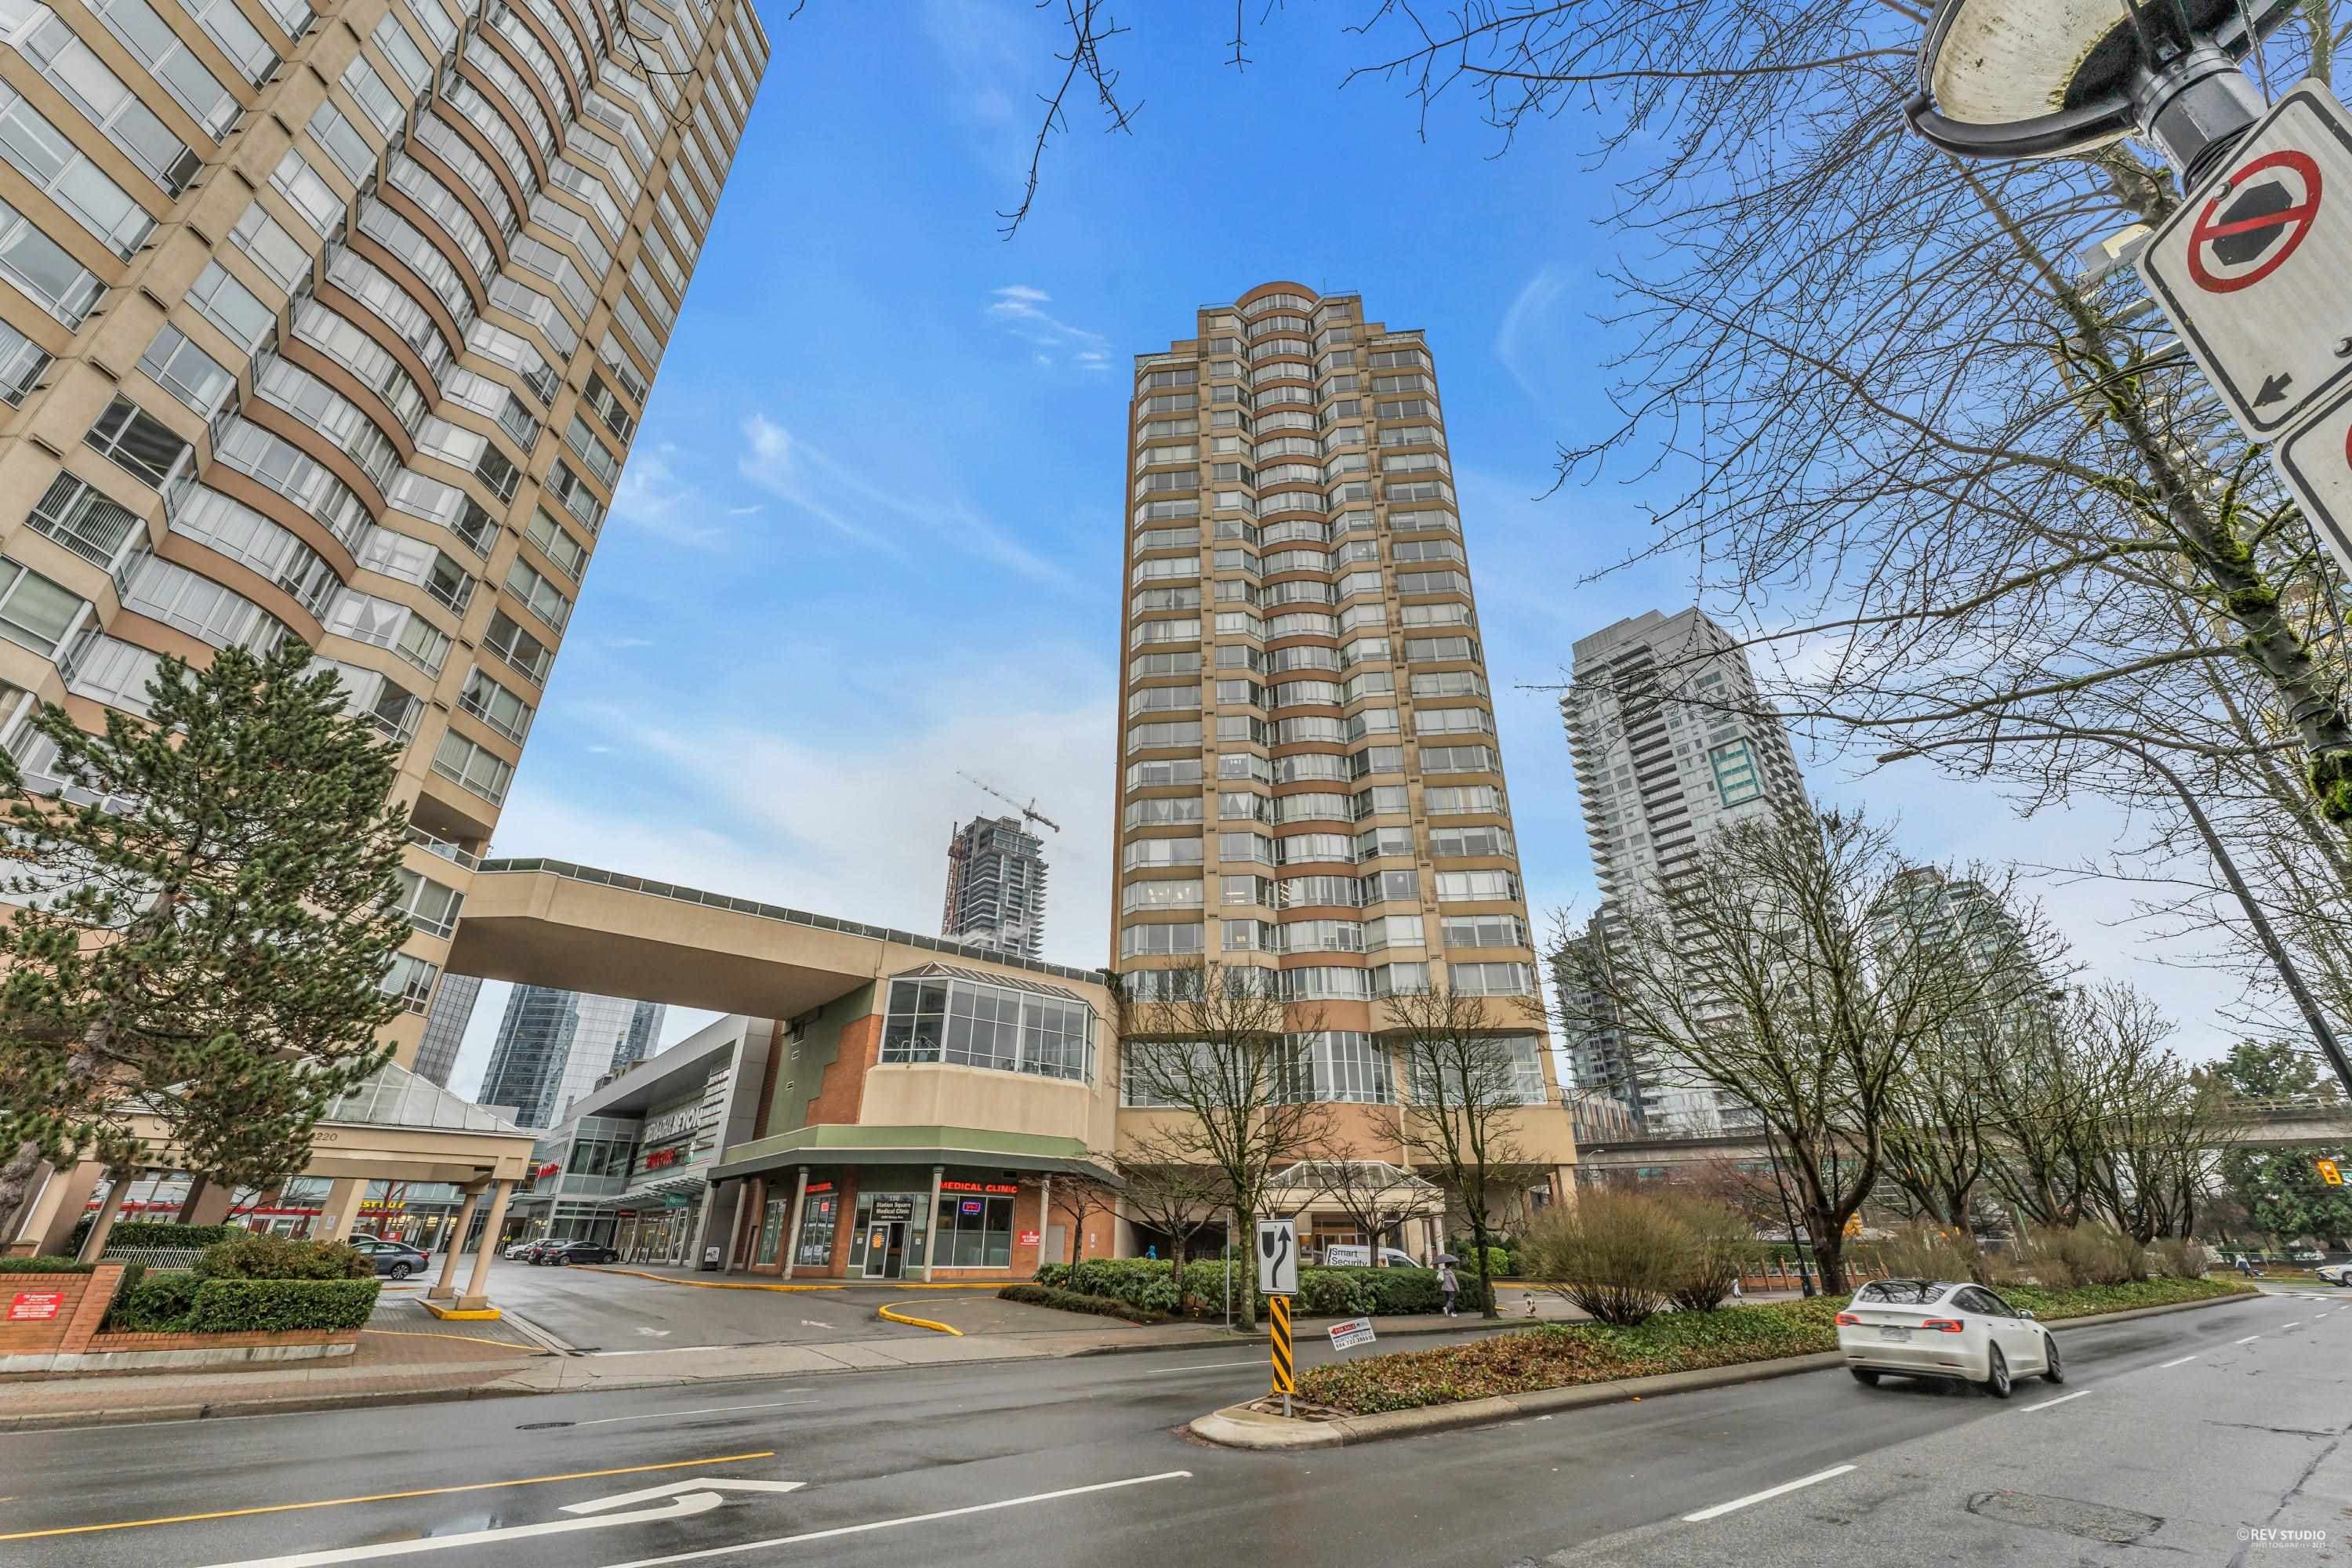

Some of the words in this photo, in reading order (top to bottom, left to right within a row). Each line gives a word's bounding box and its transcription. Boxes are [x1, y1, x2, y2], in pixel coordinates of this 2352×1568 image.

[940, 1182, 982, 1191] MEDICAL
[985, 1185, 1018, 1193] CLINIC
[1332, 1247, 1358, 1258] Smart
[1332, 1257, 1368, 1267] Security
